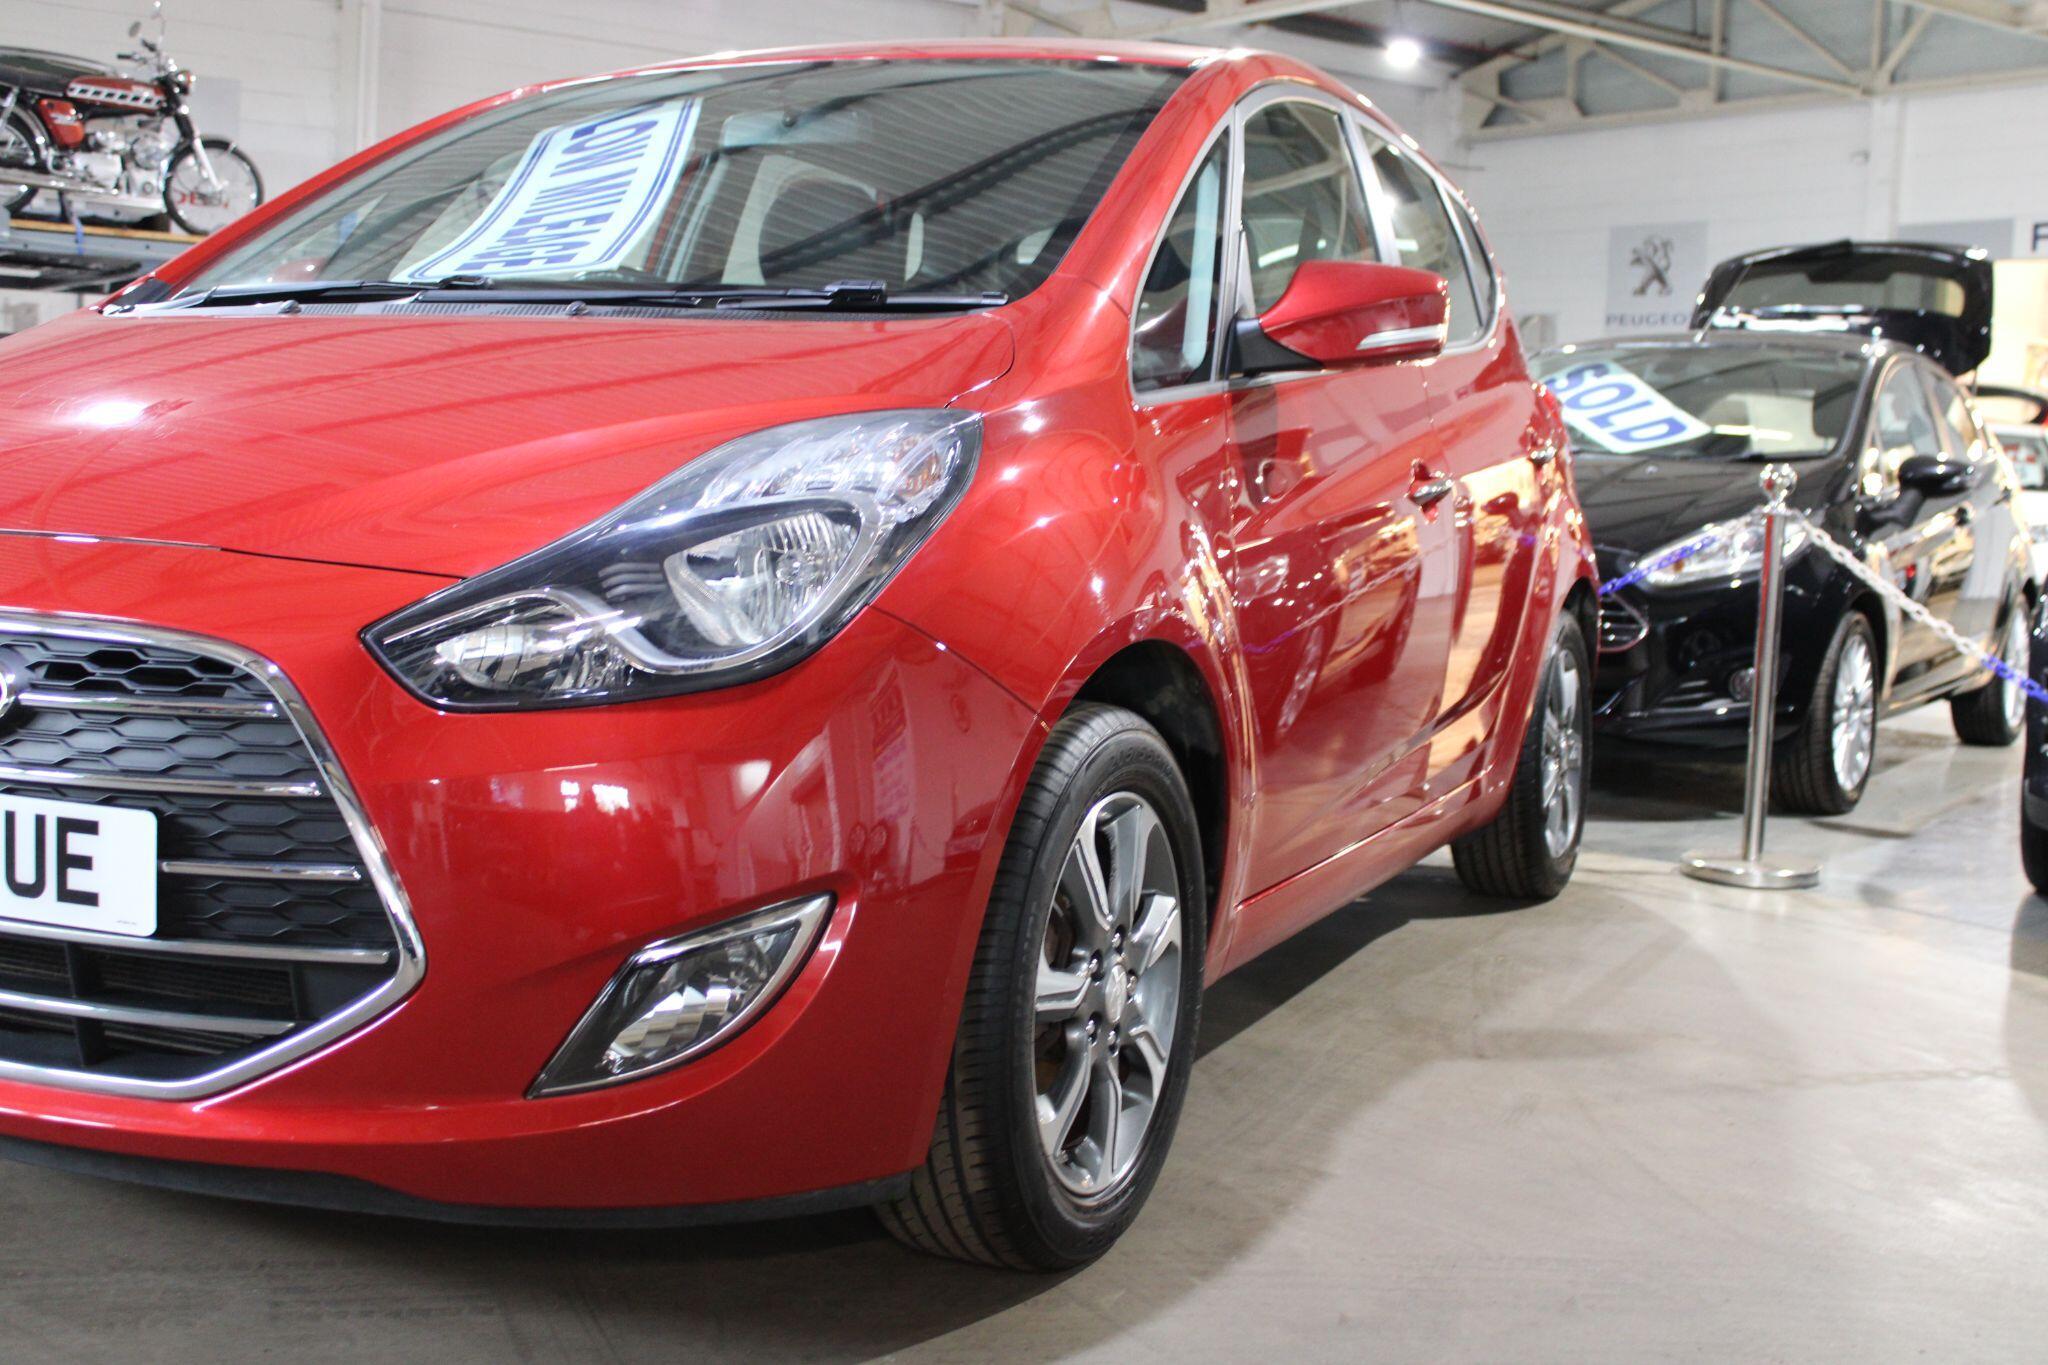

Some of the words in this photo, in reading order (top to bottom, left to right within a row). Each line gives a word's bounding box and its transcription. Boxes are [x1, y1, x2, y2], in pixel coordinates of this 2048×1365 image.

[453, 168, 638, 272] MILEAGE
[1606, 312, 1690, 328] PEUGEO
[1545, 364, 1688, 443] SOLD
[5, 810, 99, 907] UE
